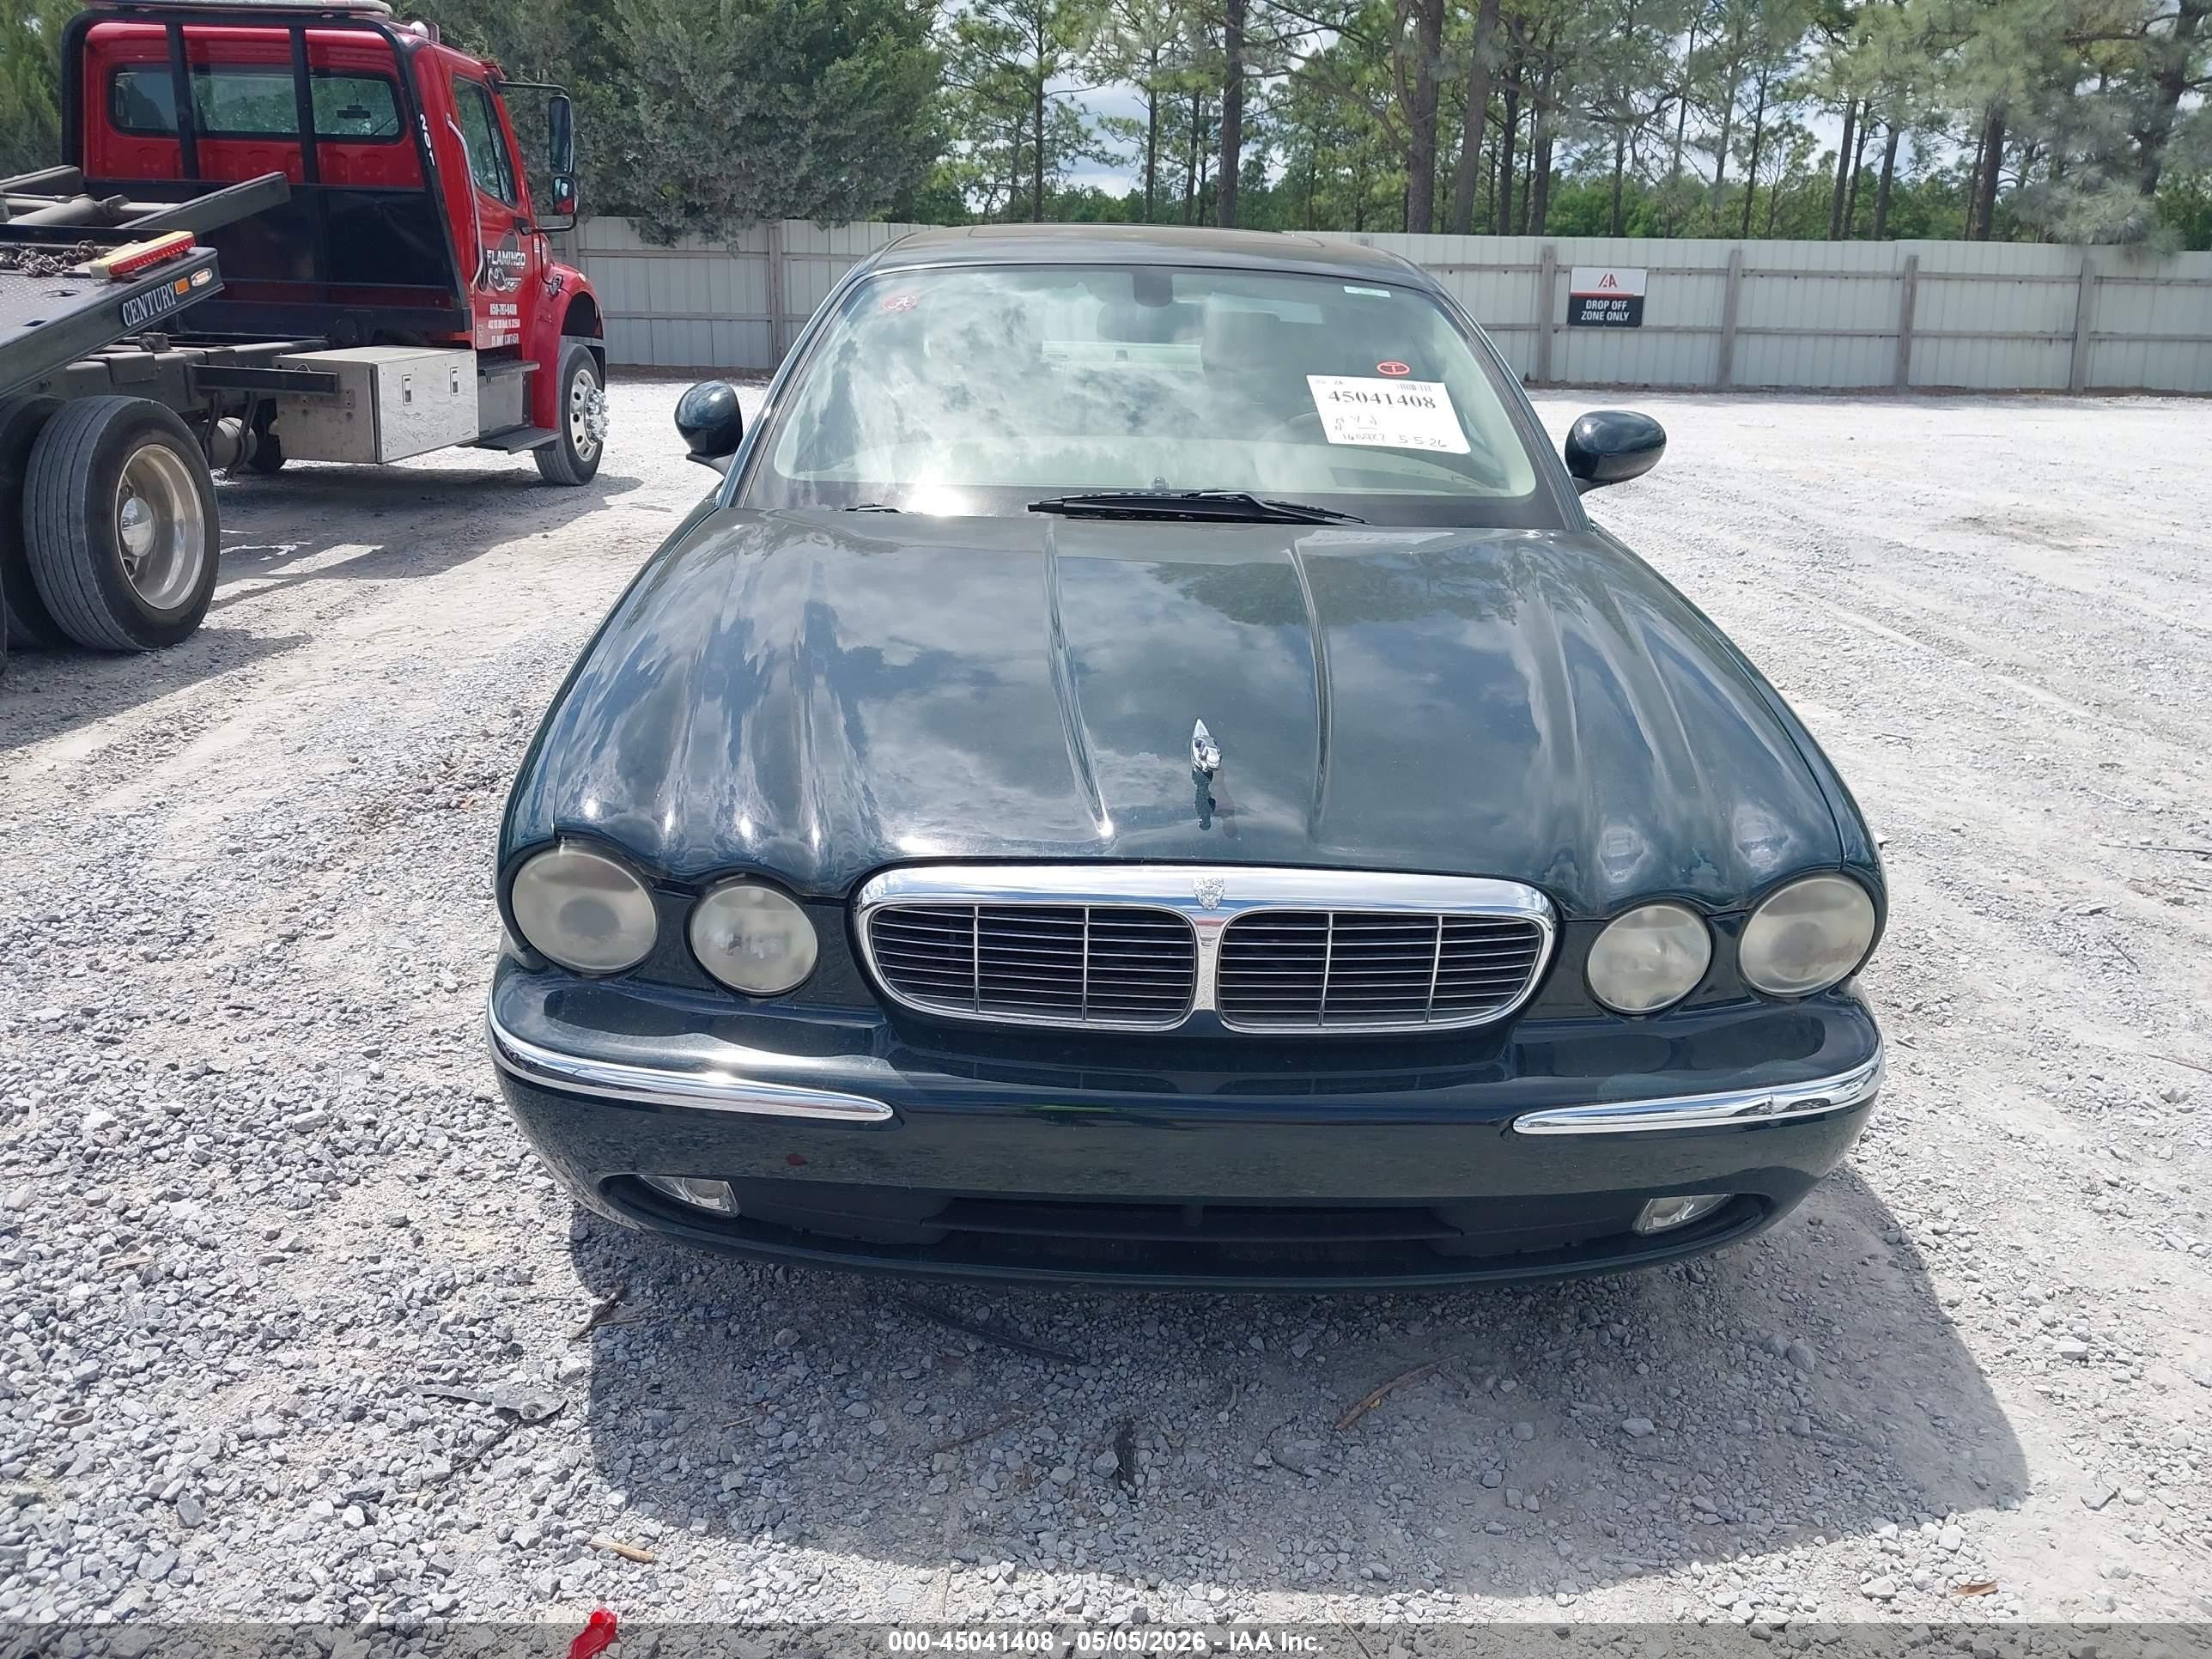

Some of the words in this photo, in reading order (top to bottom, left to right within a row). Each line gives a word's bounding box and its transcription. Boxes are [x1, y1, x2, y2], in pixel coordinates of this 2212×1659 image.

[420, 113, 435, 167] 201
[486, 249, 526, 267] FLAMINGO
[122, 281, 177, 327] CENTURY
[1585, 300, 1610, 310] DROP
[1611, 301, 1628, 311] OFF
[1581, 311, 1605, 320] ZONE
[1607, 311, 1630, 321] ONLY
[1328, 390, 1437, 409] 45041408
